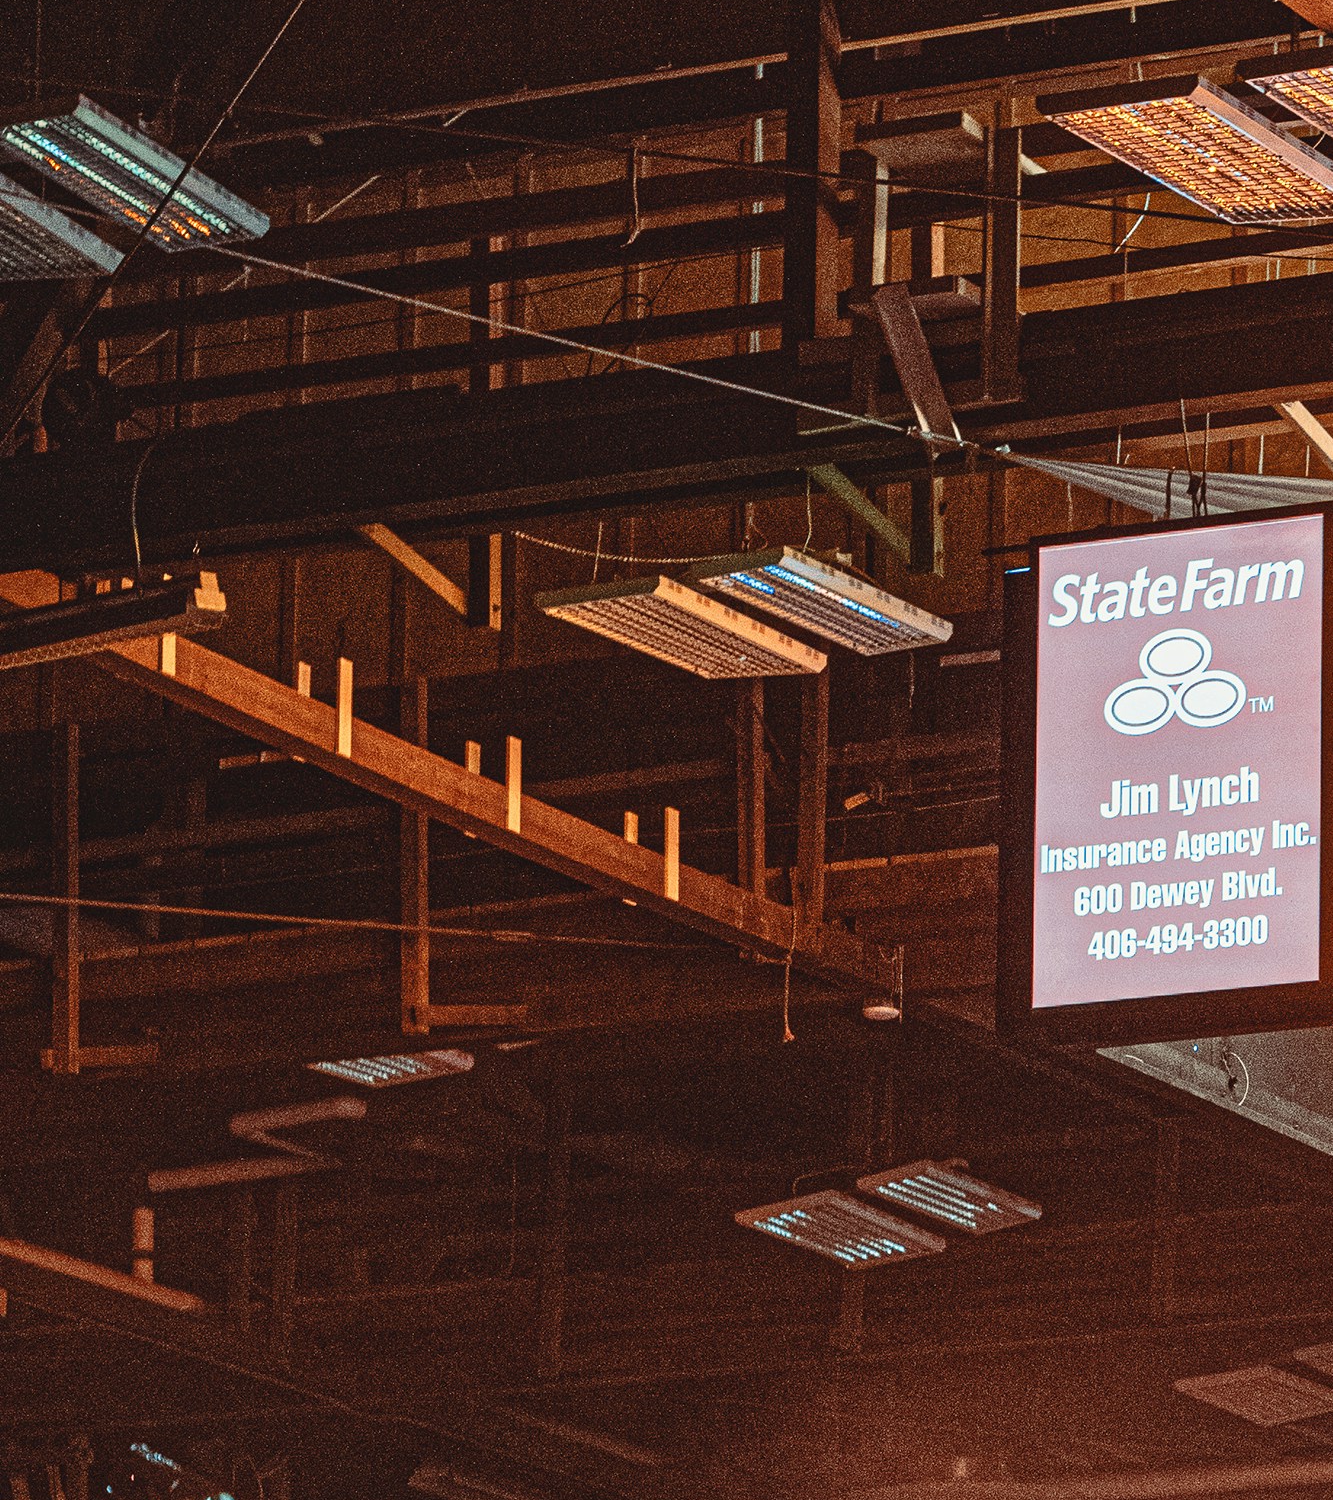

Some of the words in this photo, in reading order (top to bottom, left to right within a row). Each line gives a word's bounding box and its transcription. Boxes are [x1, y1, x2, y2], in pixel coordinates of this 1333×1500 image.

[1248, 696, 1274, 713] TM
[1100, 779, 1159, 819] Jim
[1168, 767, 1260, 816] Lynch
[1040, 842, 1167, 875] Insurance
[1174, 828, 1263, 863] Agency
[1272, 819, 1317, 850] Inc.
[1074, 885, 1123, 918] 600
[1129, 877, 1214, 912] Dewey
[1221, 868, 1284, 899] Blvd.
[1087, 914, 1268, 962] 406-494-3300
